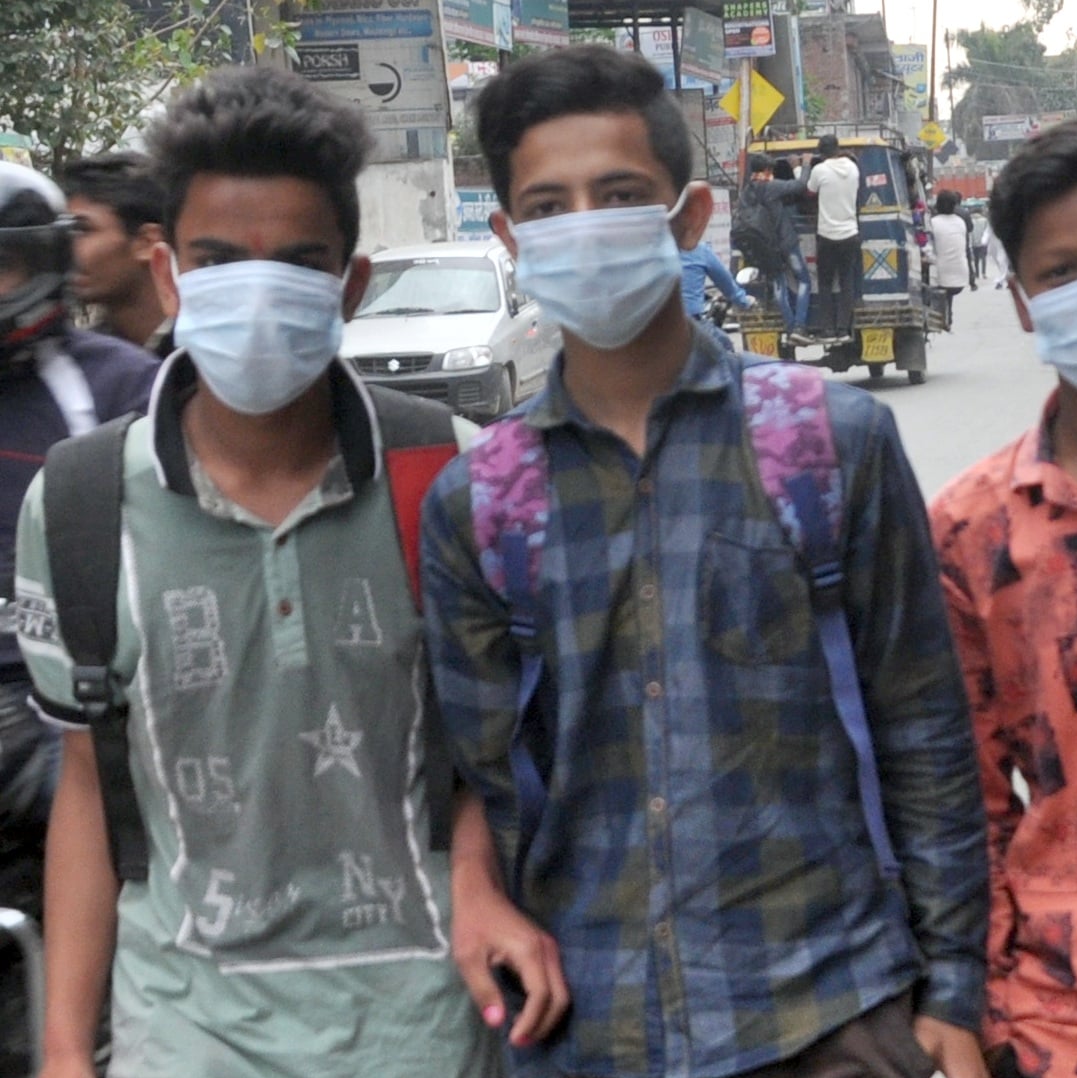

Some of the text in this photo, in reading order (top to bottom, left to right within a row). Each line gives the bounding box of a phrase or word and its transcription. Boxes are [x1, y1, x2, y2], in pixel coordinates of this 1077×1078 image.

[724, 1, 768, 11] SHAPERS
[724, 10, 768, 19] ACADEMY
[195, 866, 236, 938] 5
